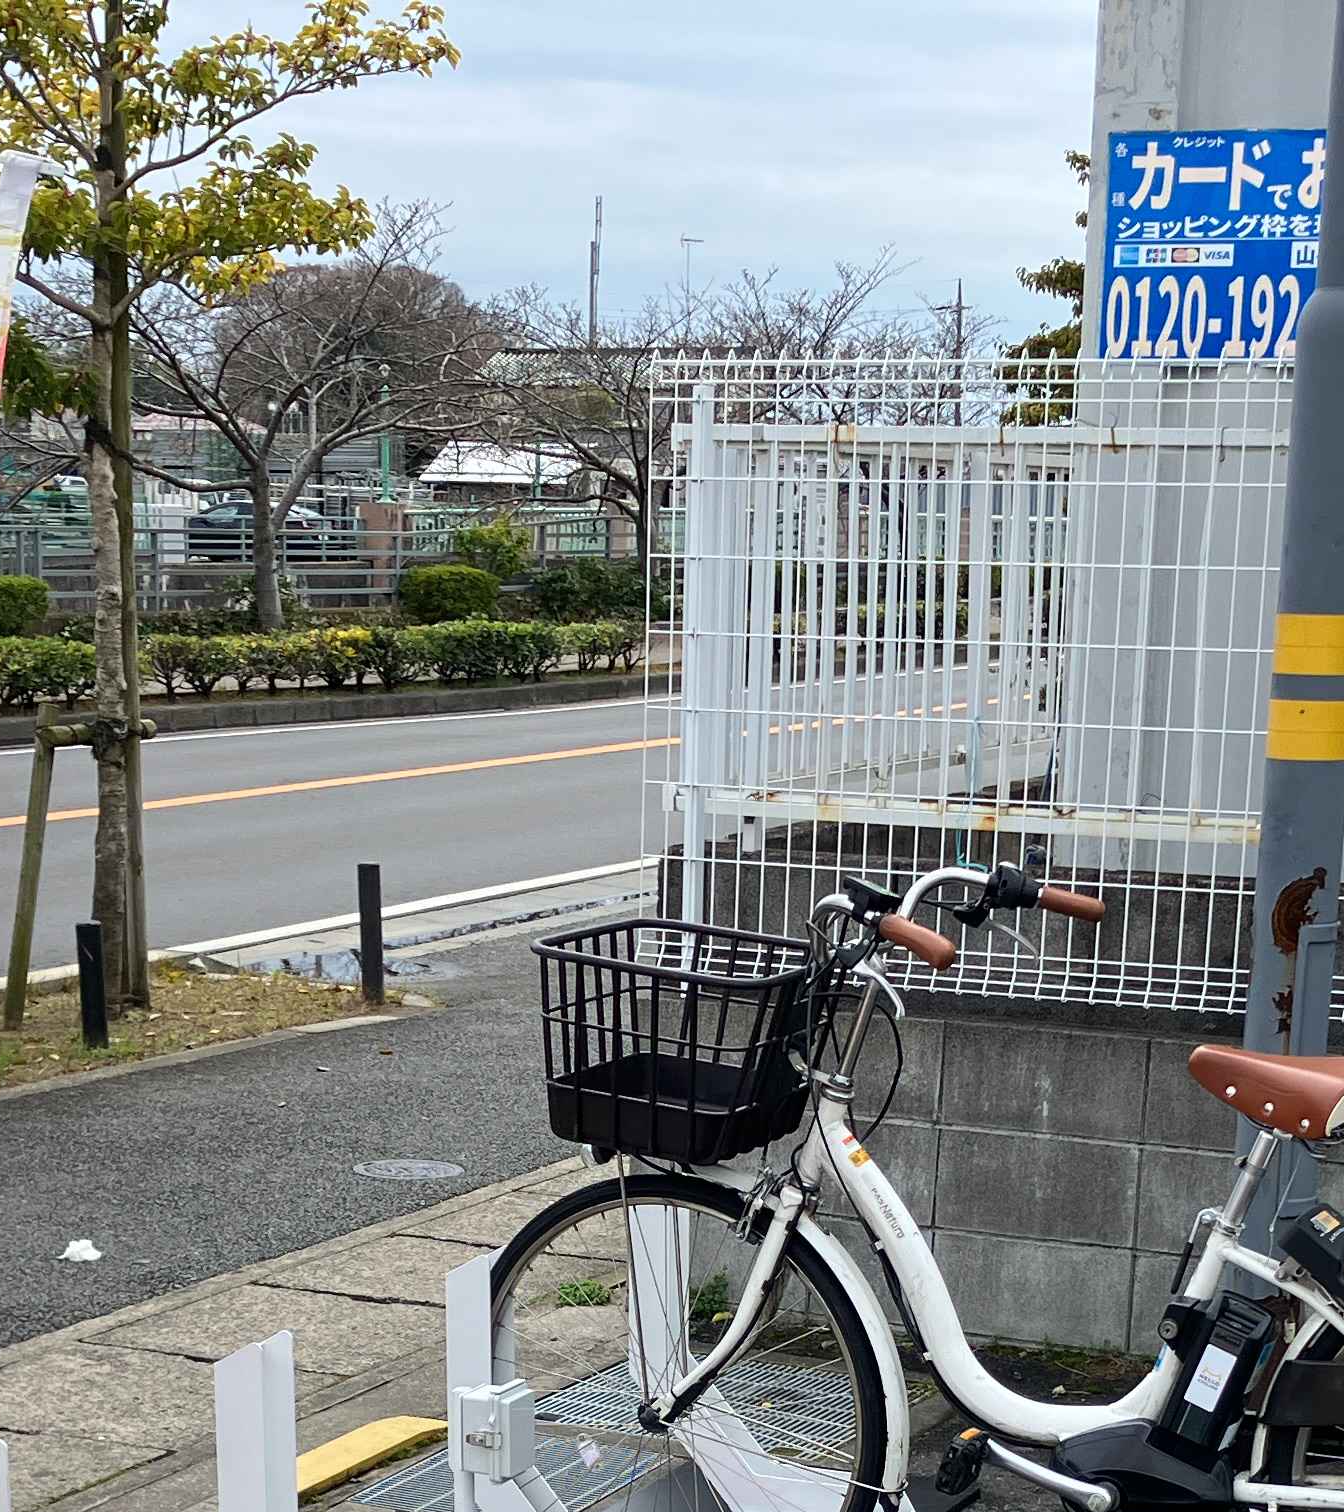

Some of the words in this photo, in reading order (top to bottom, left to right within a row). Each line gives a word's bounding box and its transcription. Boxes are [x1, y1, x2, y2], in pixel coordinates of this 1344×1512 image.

[1172, 135, 1226, 149] クレジット
[1203, 250, 1231, 260] VISA
